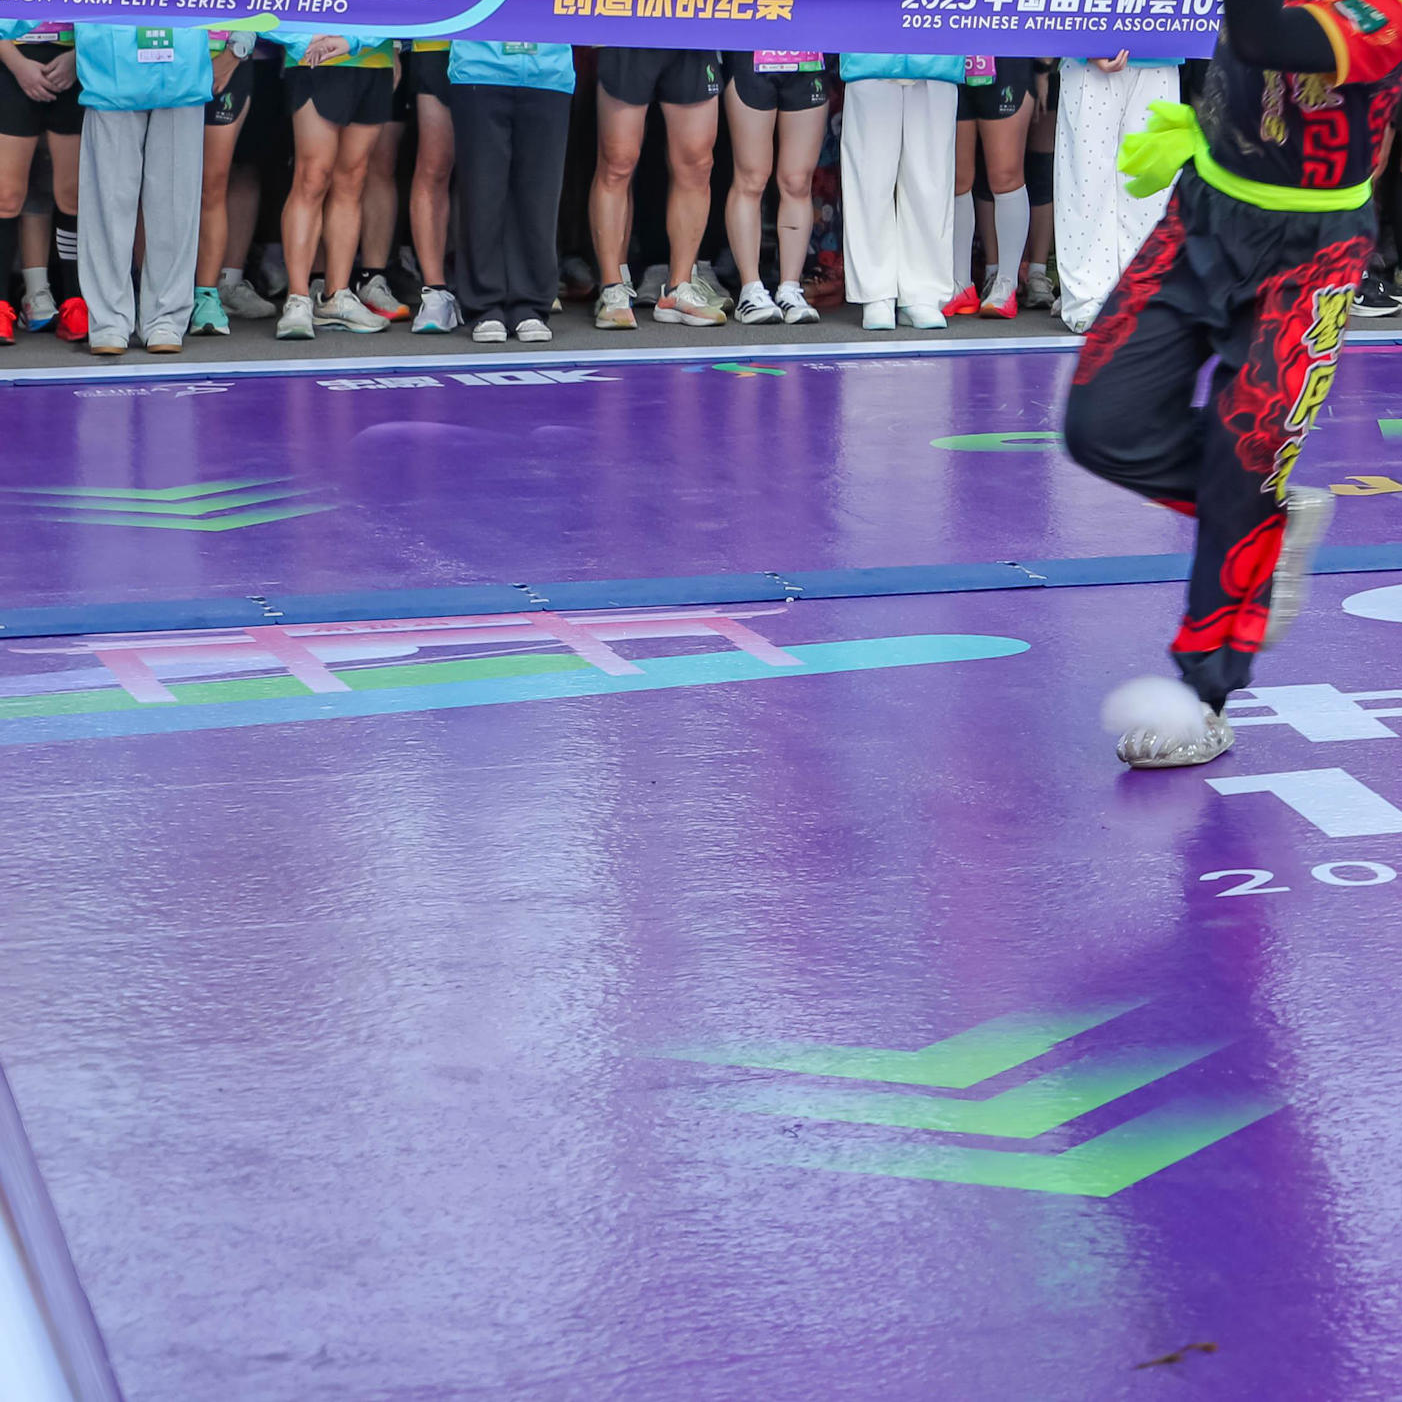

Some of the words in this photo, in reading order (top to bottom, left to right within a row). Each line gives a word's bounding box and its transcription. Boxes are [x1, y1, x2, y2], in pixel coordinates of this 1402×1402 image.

[902, 14, 942, 28] 2025
[949, 15, 1018, 30] CHINESE
[1025, 16, 1108, 32] ATHLETICS
[1113, 17, 1220, 33] ASSOCIATION
